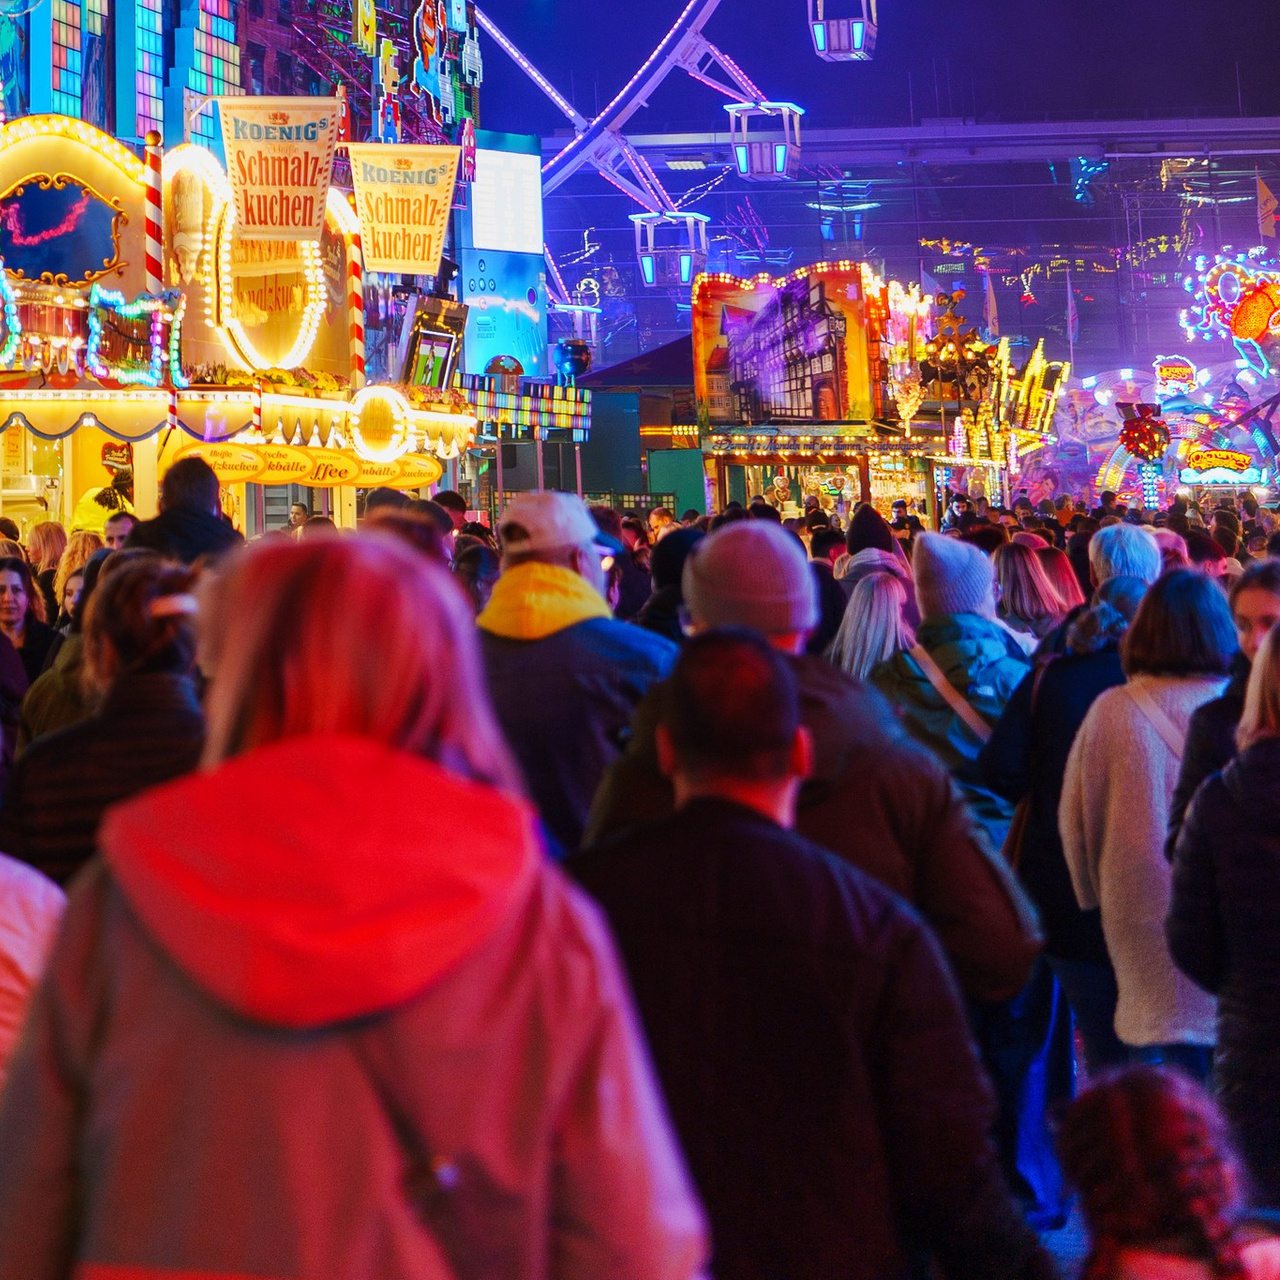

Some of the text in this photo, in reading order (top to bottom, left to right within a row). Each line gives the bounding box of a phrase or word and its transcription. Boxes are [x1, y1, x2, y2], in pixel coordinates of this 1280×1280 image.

[235, 150, 324, 188] Schmalz-
[243, 190, 315, 227] kuchen
[365, 191, 442, 227] Schmalz-
[371, 227, 433, 262] kuchen
[267, 461, 306, 473] kbälle
[309, 462, 349, 481] ffee
